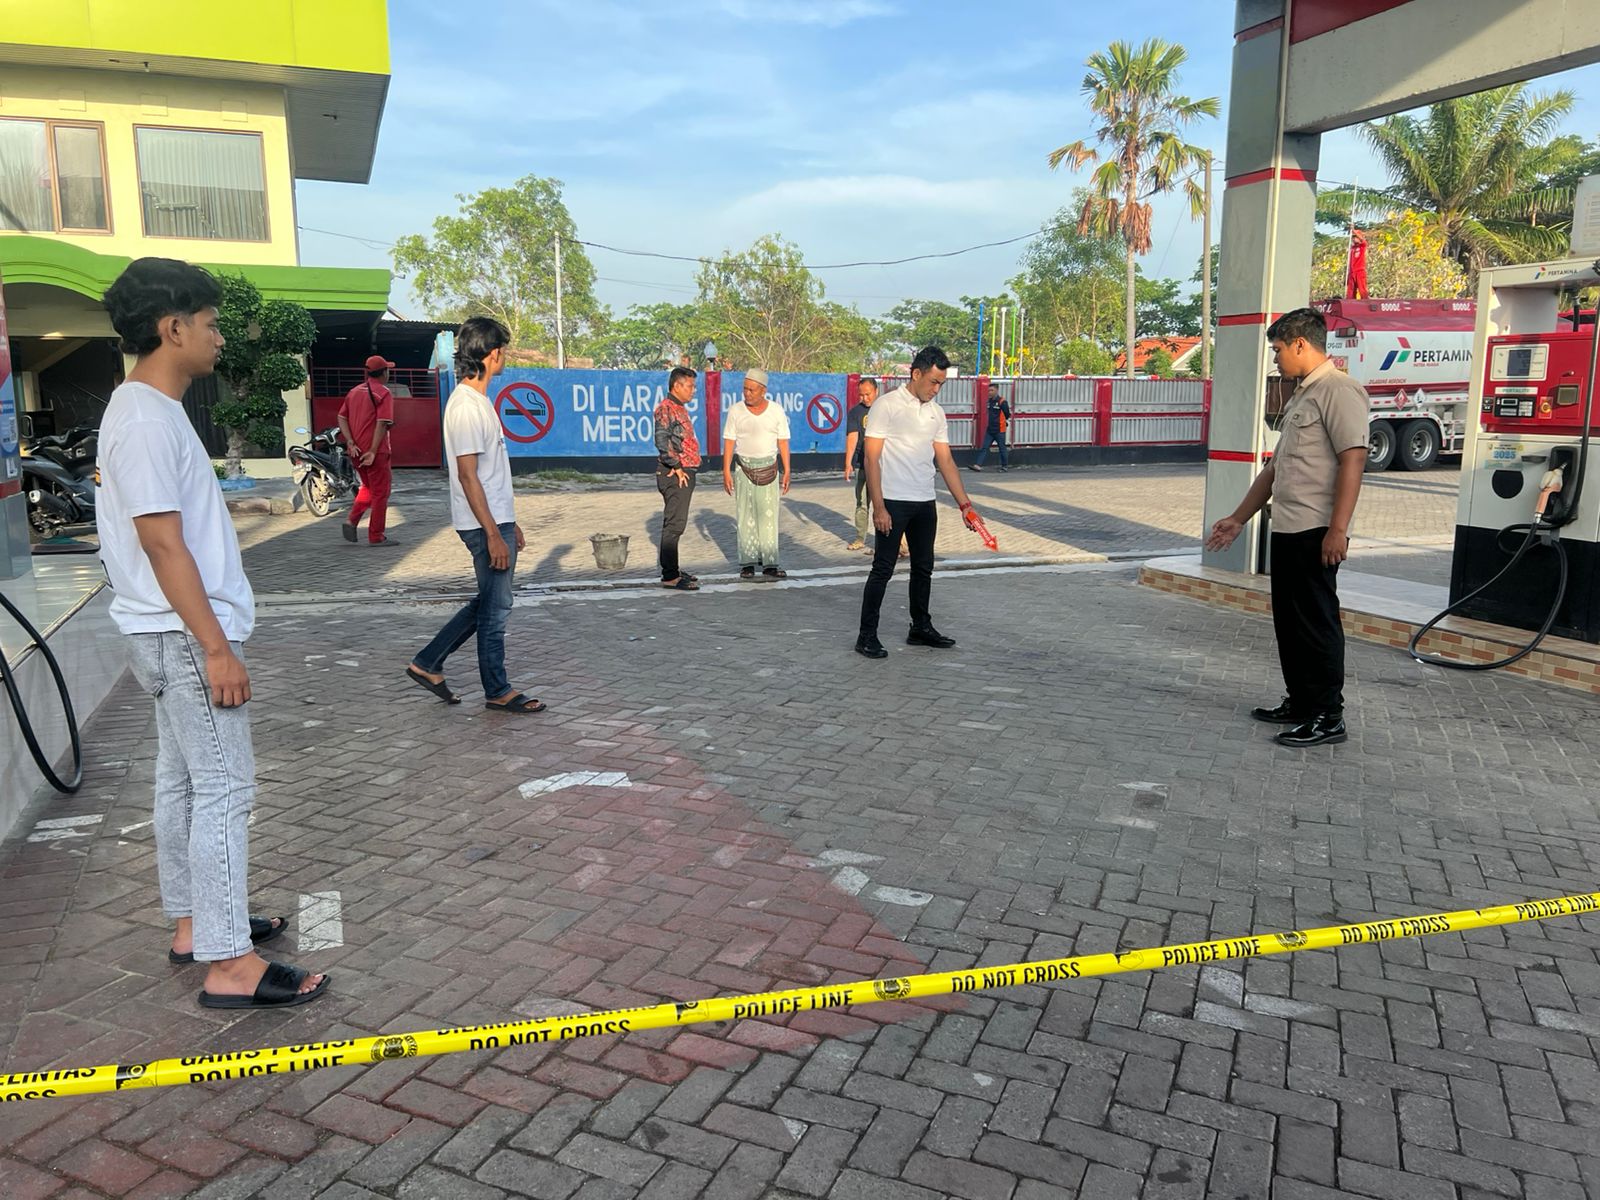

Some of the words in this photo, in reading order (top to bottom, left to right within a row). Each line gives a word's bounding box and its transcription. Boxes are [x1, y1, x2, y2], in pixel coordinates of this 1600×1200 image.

[1414, 350, 1473, 362] PERTAMIN
[573, 385, 595, 412] DI
[604, 385, 699, 412] LARAG
[1515, 900, 1566, 920] POLICE
[1566, 895, 1599, 913] LINE
[1340, 927, 1363, 944] DO
[1365, 922, 1395, 941] NOT
[1399, 915, 1450, 937] CROSS
[1162, 943, 1220, 967] POLICE
[1225, 939, 1261, 959] LINE
[952, 975, 976, 993] DO
[983, 970, 1016, 989] NOT
[1023, 962, 1080, 984] CROSS
